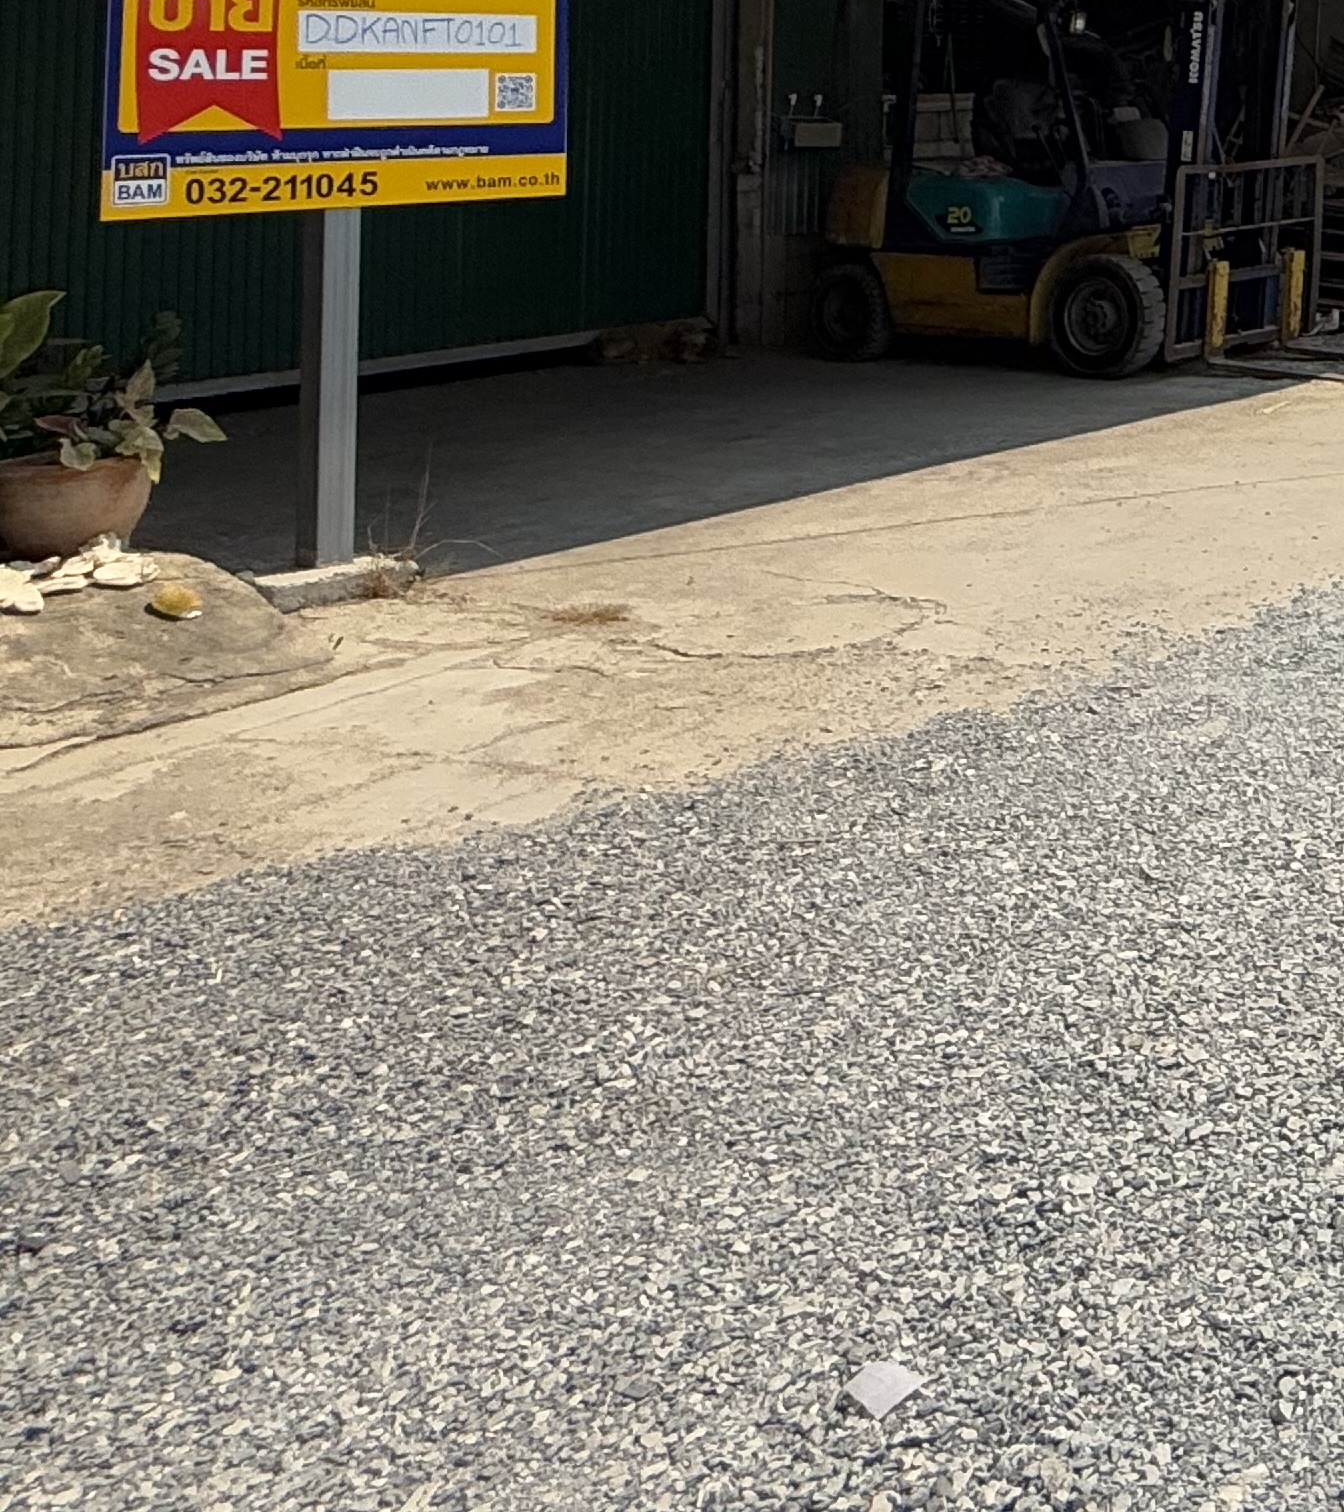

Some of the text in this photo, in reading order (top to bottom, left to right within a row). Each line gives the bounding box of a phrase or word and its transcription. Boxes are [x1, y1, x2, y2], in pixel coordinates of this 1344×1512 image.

[1188, 10, 1204, 84] KOMATSU
[148, 48, 269, 81] SALE
[116, 160, 164, 179] บสก
[185, 171, 378, 205] 032-211045
[425, 172, 560, 191] www.bam.co.th
[117, 184, 163, 200] BAM
[946, 205, 973, 225] 20
